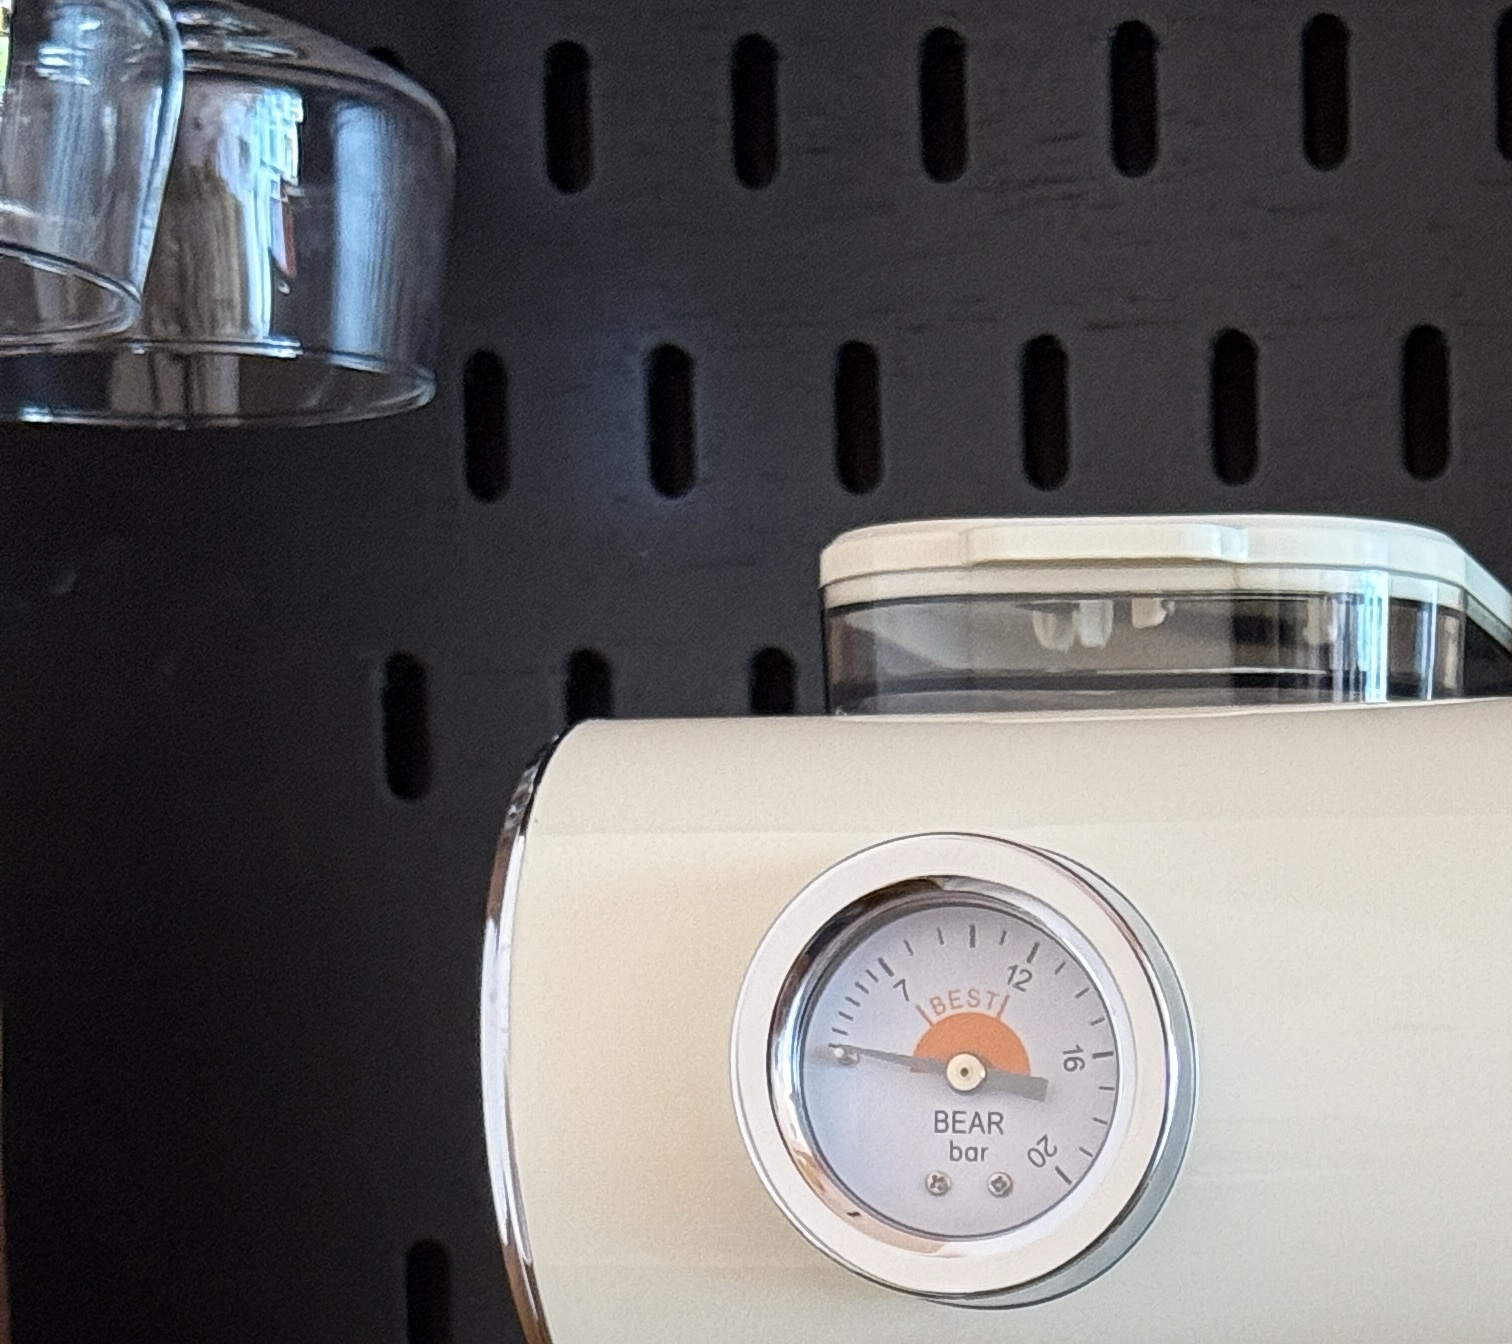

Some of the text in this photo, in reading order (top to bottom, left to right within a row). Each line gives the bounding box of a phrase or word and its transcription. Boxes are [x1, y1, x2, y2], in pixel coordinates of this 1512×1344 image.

[893, 978, 910, 1002] 7
[1007, 964, 1033, 993] 12
[928, 988, 1000, 1017] BEST
[1062, 1044, 1086, 1073] 16
[934, 1110, 1004, 1135] BEAR
[949, 1139, 989, 1162] bar
[1027, 1134, 1058, 1168] 20
